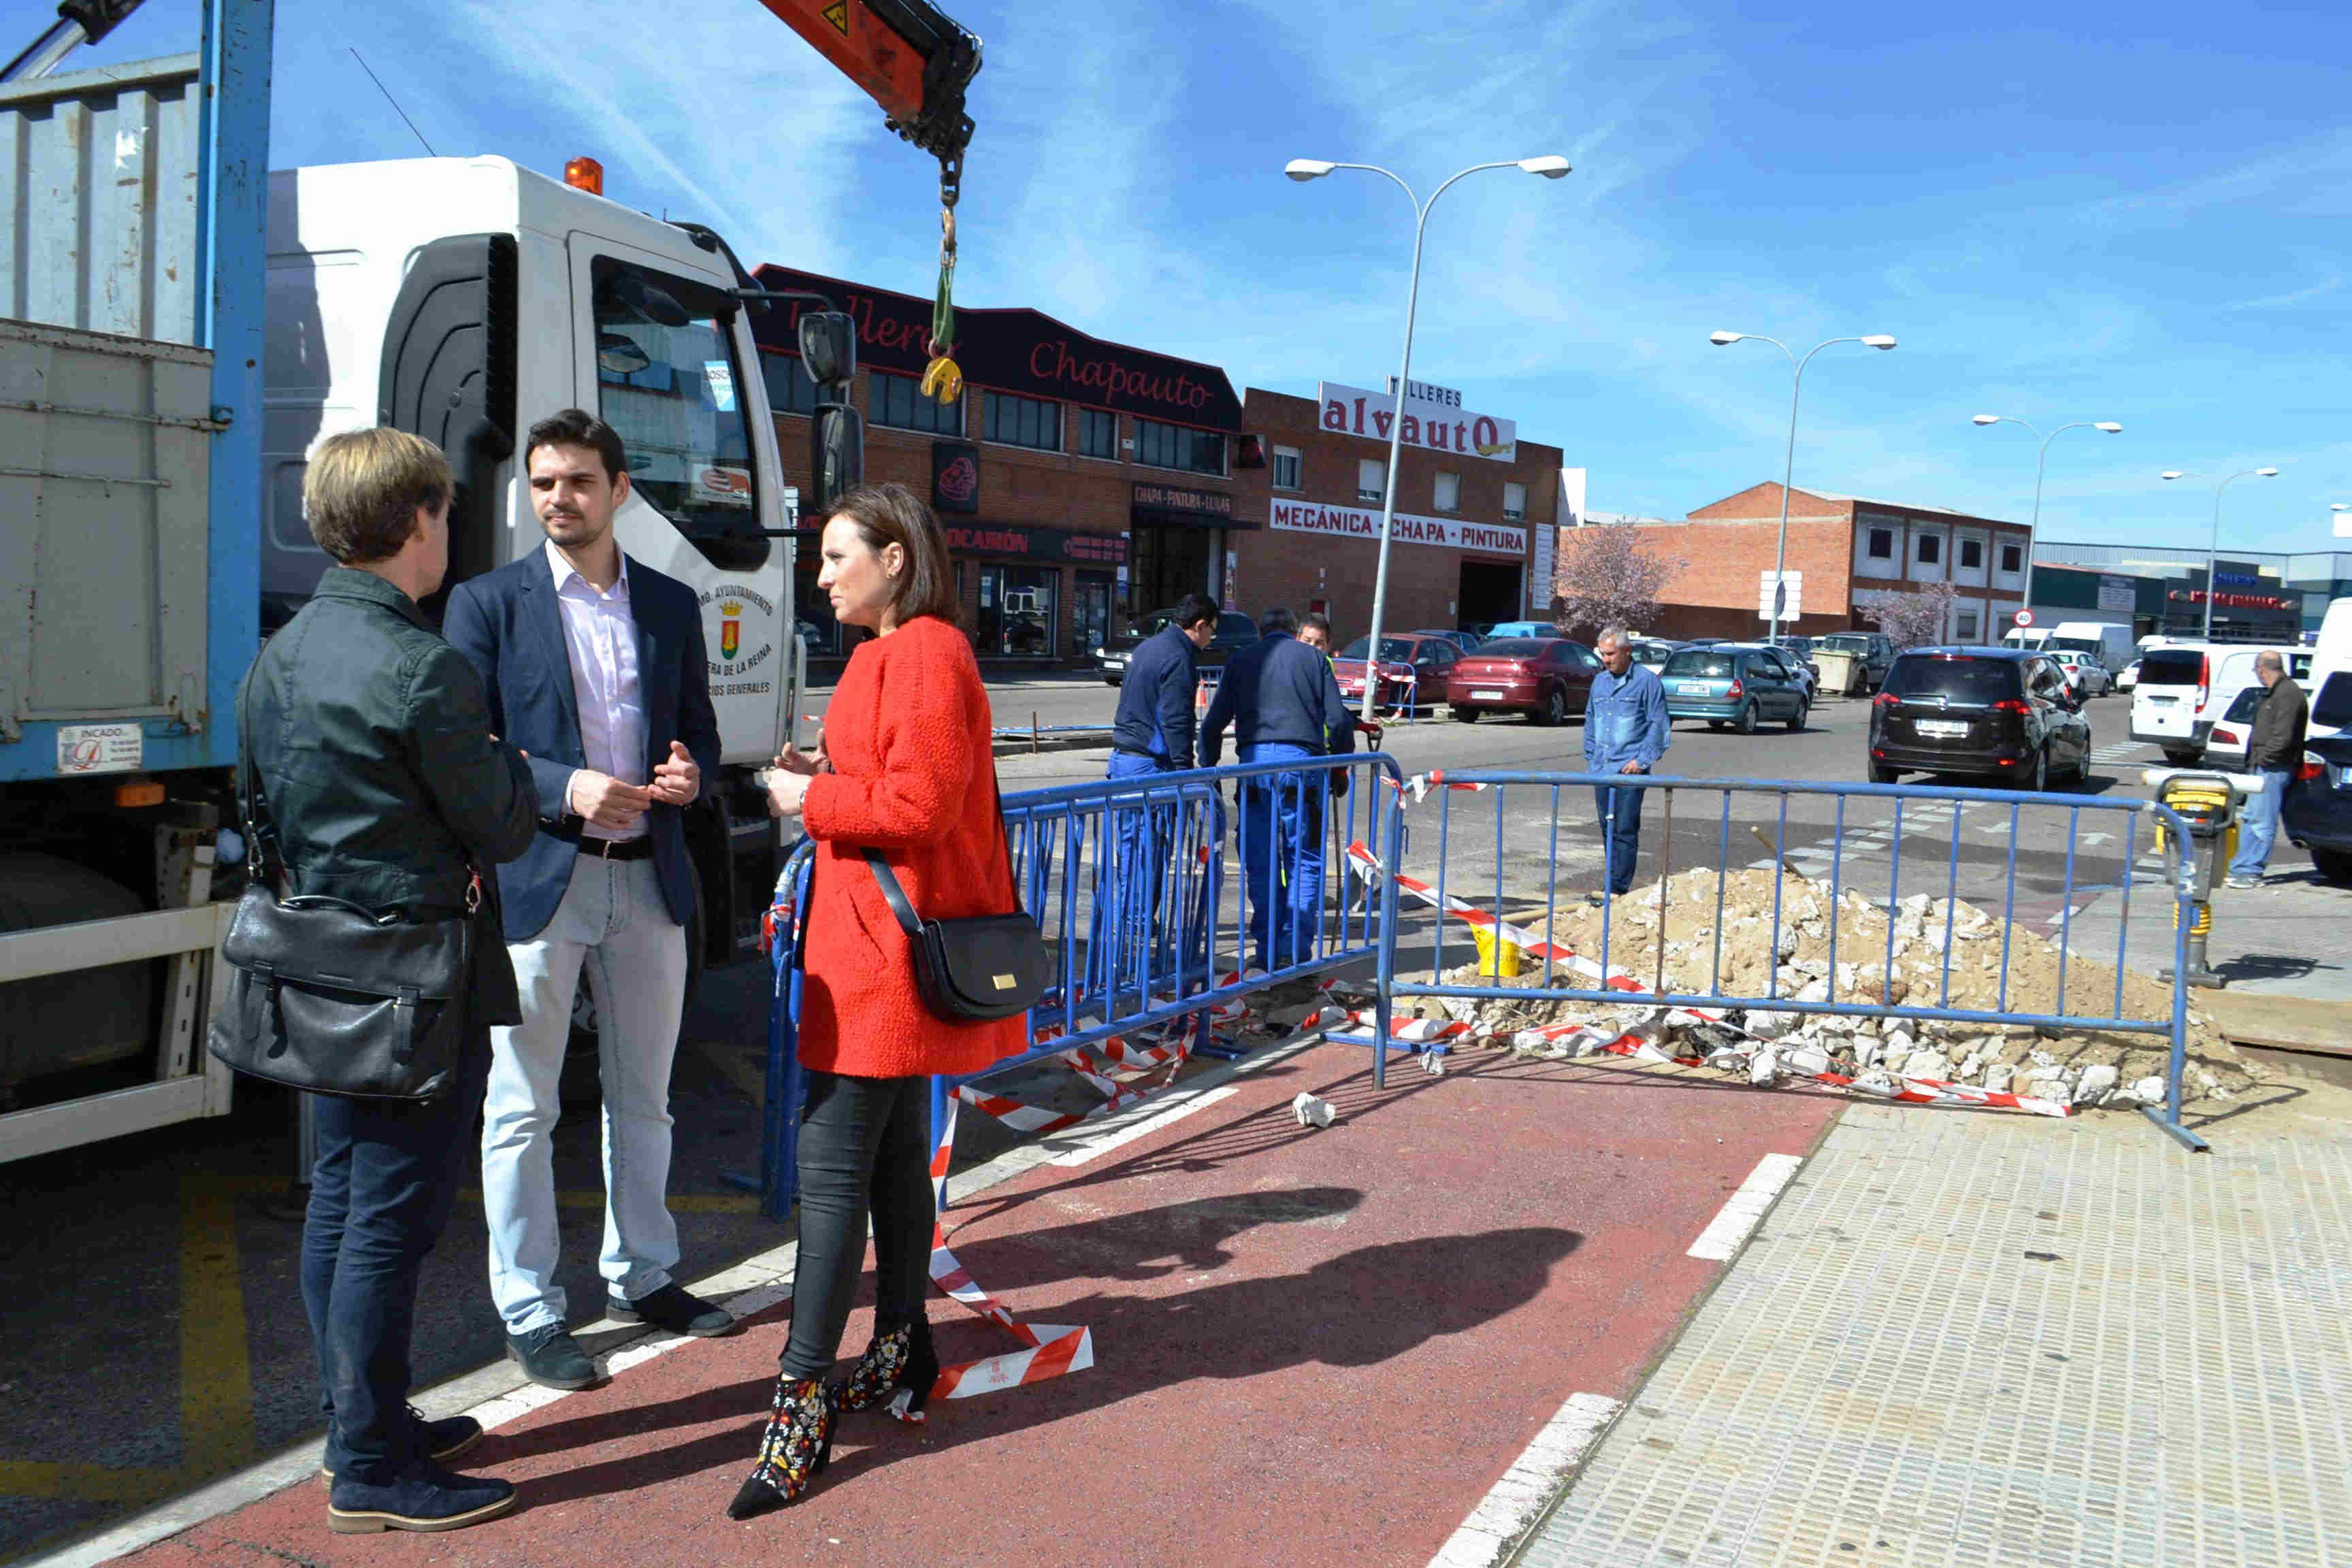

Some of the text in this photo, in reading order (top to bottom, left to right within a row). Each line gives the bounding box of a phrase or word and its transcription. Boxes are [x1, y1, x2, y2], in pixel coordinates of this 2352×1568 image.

[1028, 340, 1215, 409] Chapauto
[1390, 378, 1462, 408] TLLERES
[1275, 504, 1372, 534] MECÁNICA
[1392, 519, 1446, 542] CHAPA
[1461, 527, 1524, 551] PINTURA
[715, 585, 773, 616] AYUNTAMIENTO
[723, 664, 734, 676] DE
[736, 662, 747, 674] LA
[747, 643, 772, 670] REINA
[726, 681, 770, 696] GENERALES
[81, 728, 120, 738] INCADO
